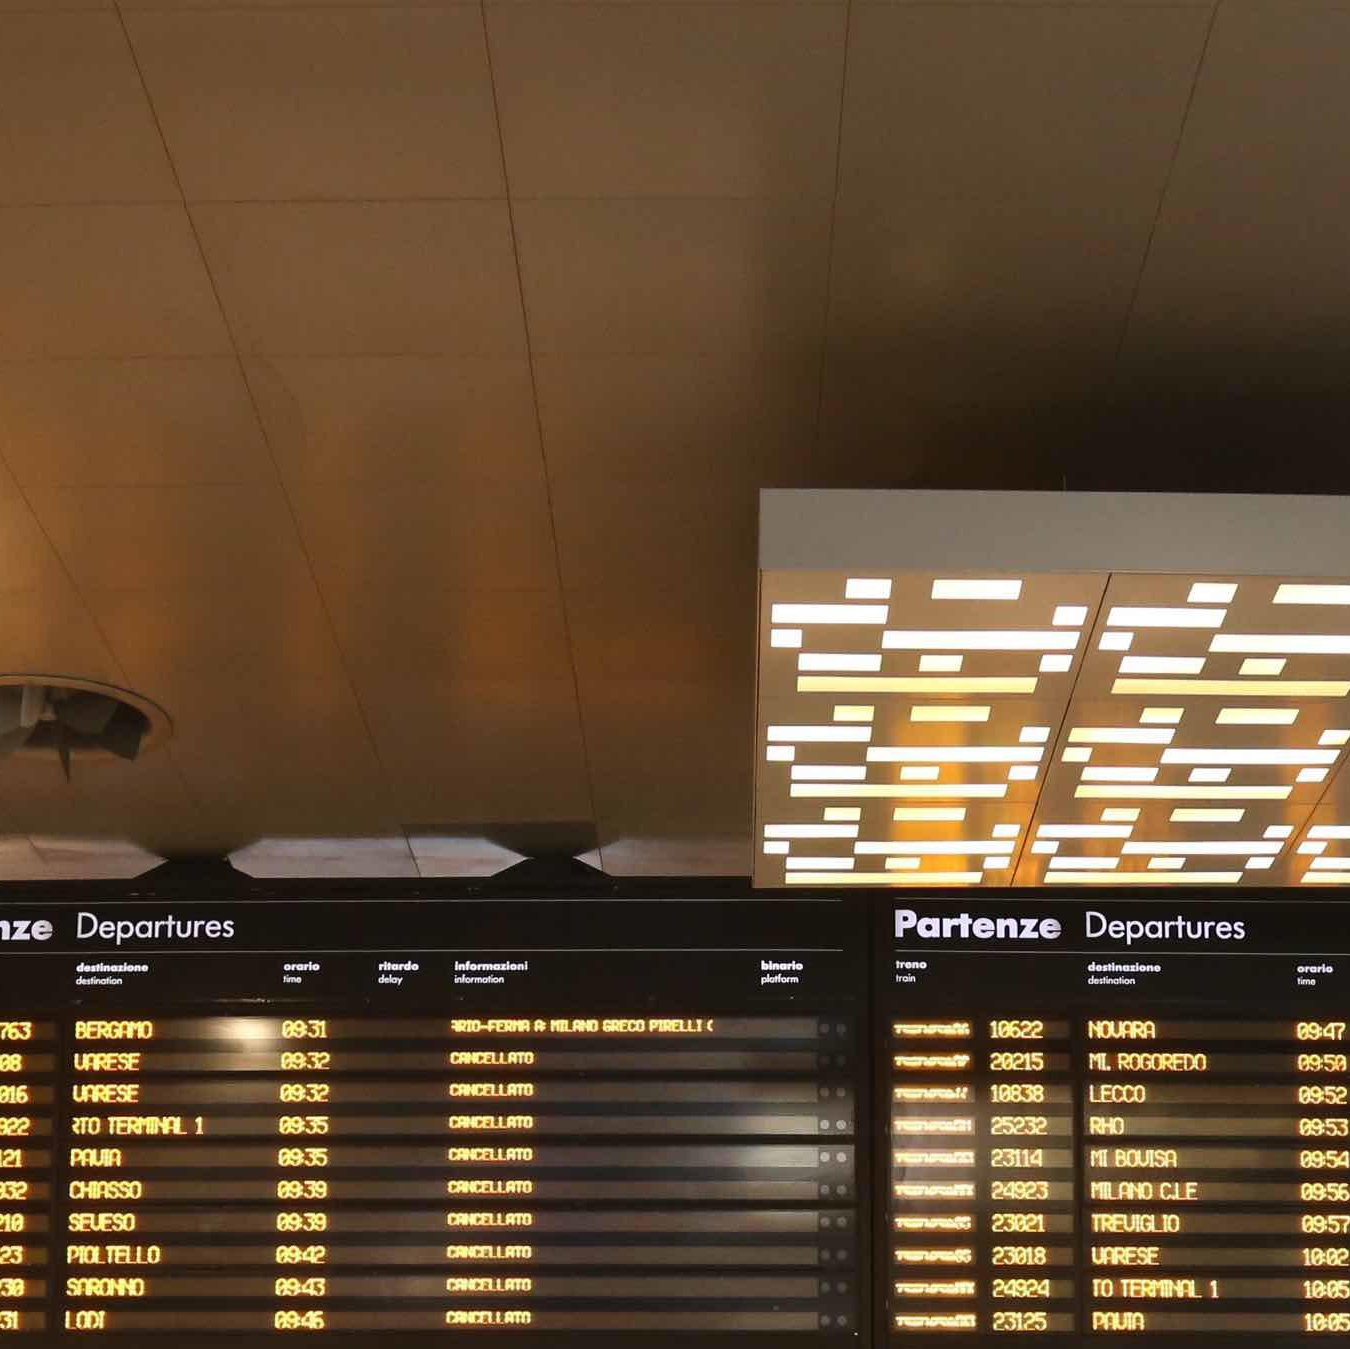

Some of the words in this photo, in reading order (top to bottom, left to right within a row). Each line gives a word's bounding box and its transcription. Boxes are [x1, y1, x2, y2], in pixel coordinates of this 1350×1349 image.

[76, 912, 234, 945] Departures
[895, 910, 1061, 938] Partenze
[1086, 912, 1245, 945] Departures
[76, 962, 149, 972] destinazione
[283, 962, 319, 971] orario
[379, 961, 418, 971] ritardo
[455, 961, 528, 971] informazioni
[761, 961, 803, 970] binario
[896, 960, 927, 969] treno
[1088, 963, 1160, 972] destinazione
[1297, 964, 1333, 973] orario
[76, 976, 122, 985] destination
[283, 975, 301, 983] time
[378, 974, 403, 986] delay
[454, 974, 504, 984] information
[761, 974, 799, 985] platform
[896, 973, 916, 982] train
[1088, 976, 1135, 986] destination
[1297, 977, 1315, 986] time
[75, 1021, 153, 1039] BERGAMO
[1089, 1021, 1155, 1038] NOVARA
[74, 1053, 140, 1070] VARESE
[1118, 1053, 1206, 1071] ROGOREDO
[73, 1084, 139, 1102] VARESE
[1090, 1085, 1146, 1103] LECCO
[108, 1117, 187, 1134] TERMINAL
[1090, 1117, 1125, 1135] RHO
[70, 1149, 121, 1167] PAVIA
[1113, 1149, 1177, 1167] BOVISA
[69, 1181, 142, 1199] CHIASSO
[1091, 1182, 1155, 1200] MILANO
[68, 1213, 135, 1231] SEVESO
[1092, 1214, 1180, 1232] TREVIGLIO
[67, 1246, 160, 1264] PIOLTELLO
[1092, 1247, 1159, 1265] VARESE
[67, 1278, 144, 1296] SARONNO
[1093, 1279, 1114, 1297] TO
[1120, 1279, 1202, 1297] TERMINAL
[1210, 1280, 1219, 1298] 1
[1093, 1312, 1145, 1330] PAVIA
